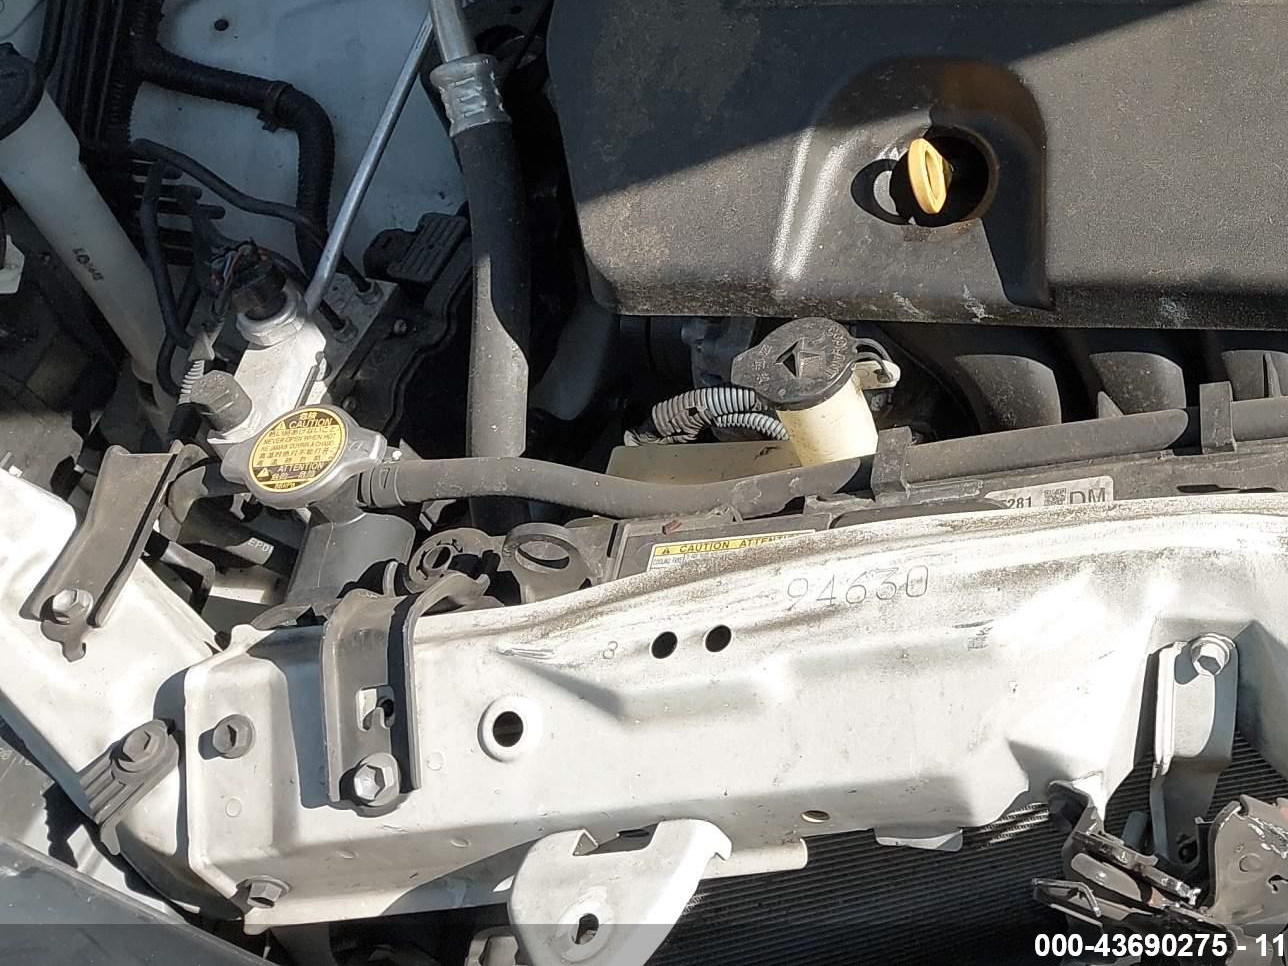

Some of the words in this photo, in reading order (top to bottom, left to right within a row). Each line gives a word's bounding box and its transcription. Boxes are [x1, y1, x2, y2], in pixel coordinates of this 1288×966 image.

[288, 418, 333, 430] CAUTION
[277, 462, 325, 473] ATTENTION
[1069, 487, 1107, 505] DM
[679, 541, 731, 553] CAUTION
[785, 565, 929, 610] 94630
